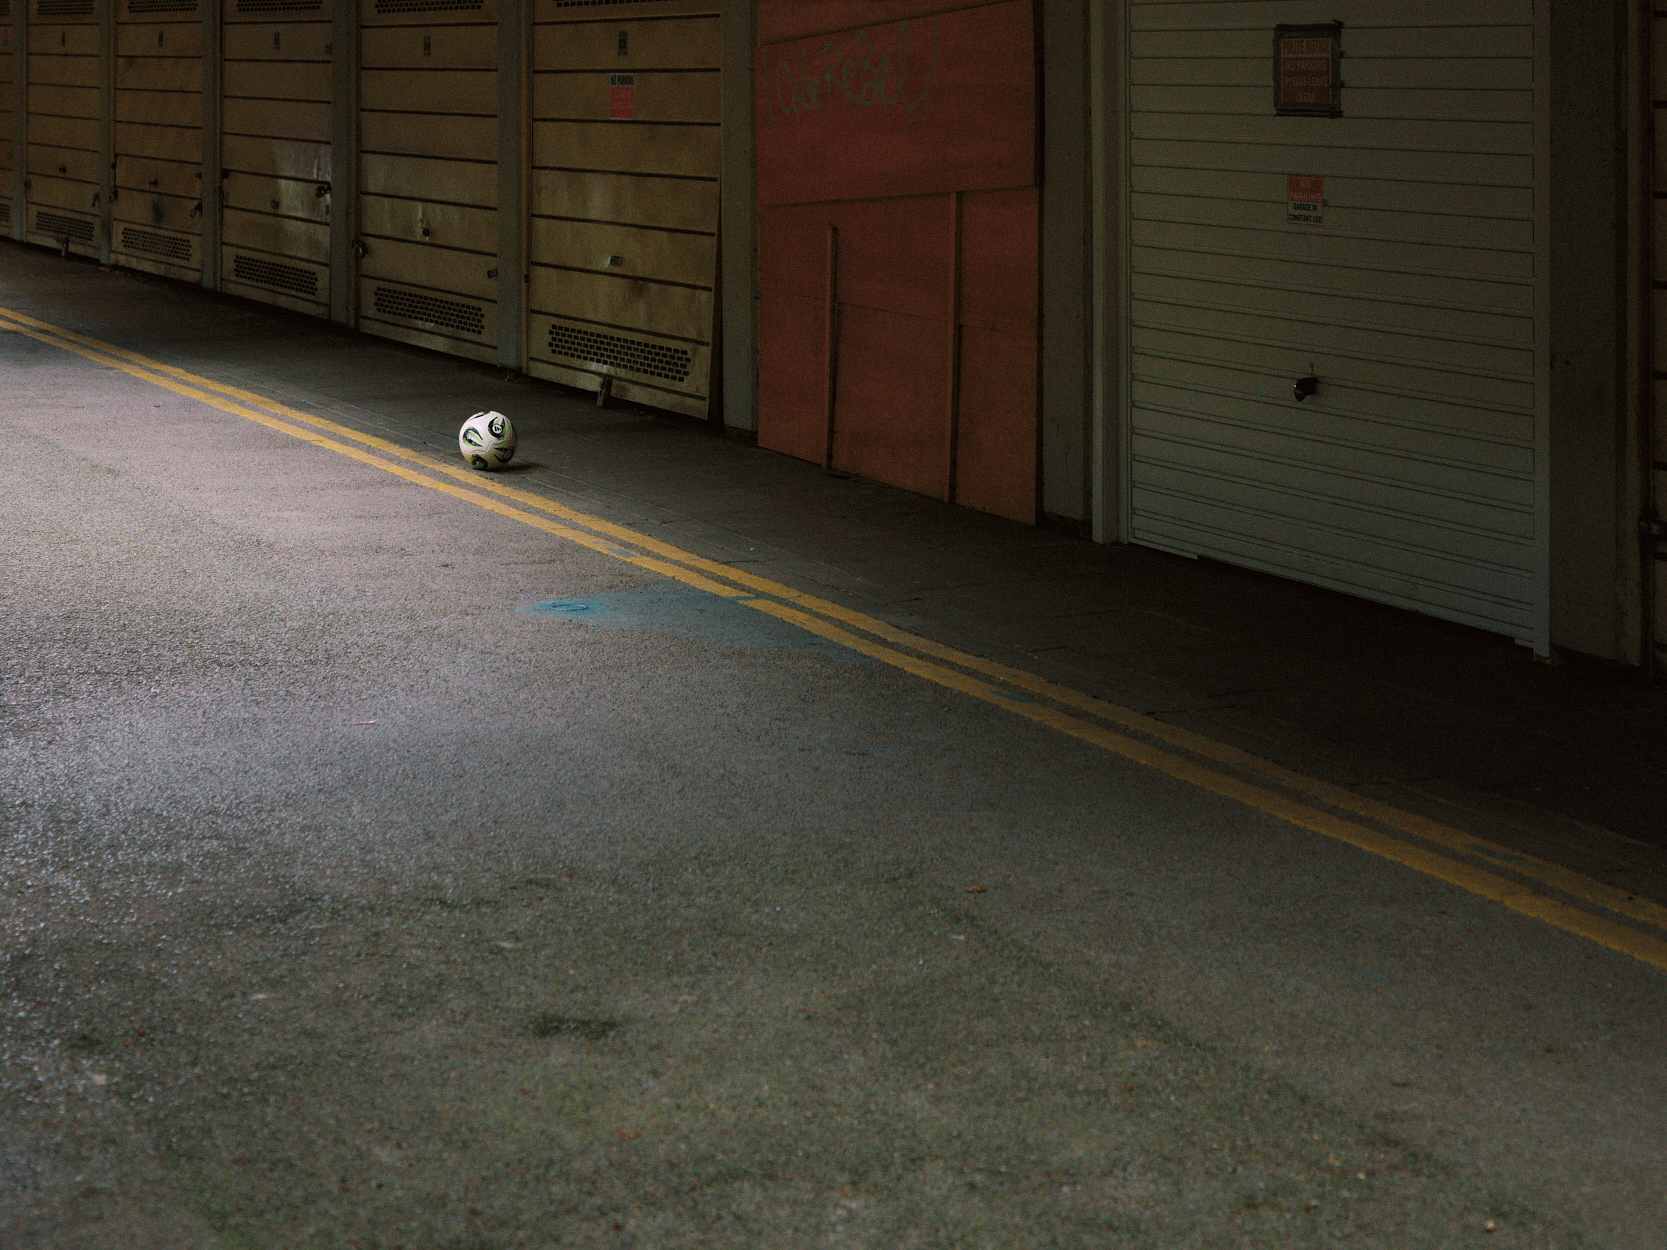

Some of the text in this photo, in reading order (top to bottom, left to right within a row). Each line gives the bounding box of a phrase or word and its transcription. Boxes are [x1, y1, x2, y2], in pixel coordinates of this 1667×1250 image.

[1282, 39, 1330, 55] POLITE NOTICE
[1285, 59, 1327, 71] NO PARKING
[617, 75, 633, 85] PARKING
[1284, 76, 1328, 87] PLEASE LEAVE
[1296, 92, 1316, 103] CLEAR
[1300, 179, 1310, 188] NO
[1289, 191, 1322, 201] PARKING
[1293, 203, 1311, 211] GARAGE
[1289, 213, 1322, 223] CONSTANT USE
